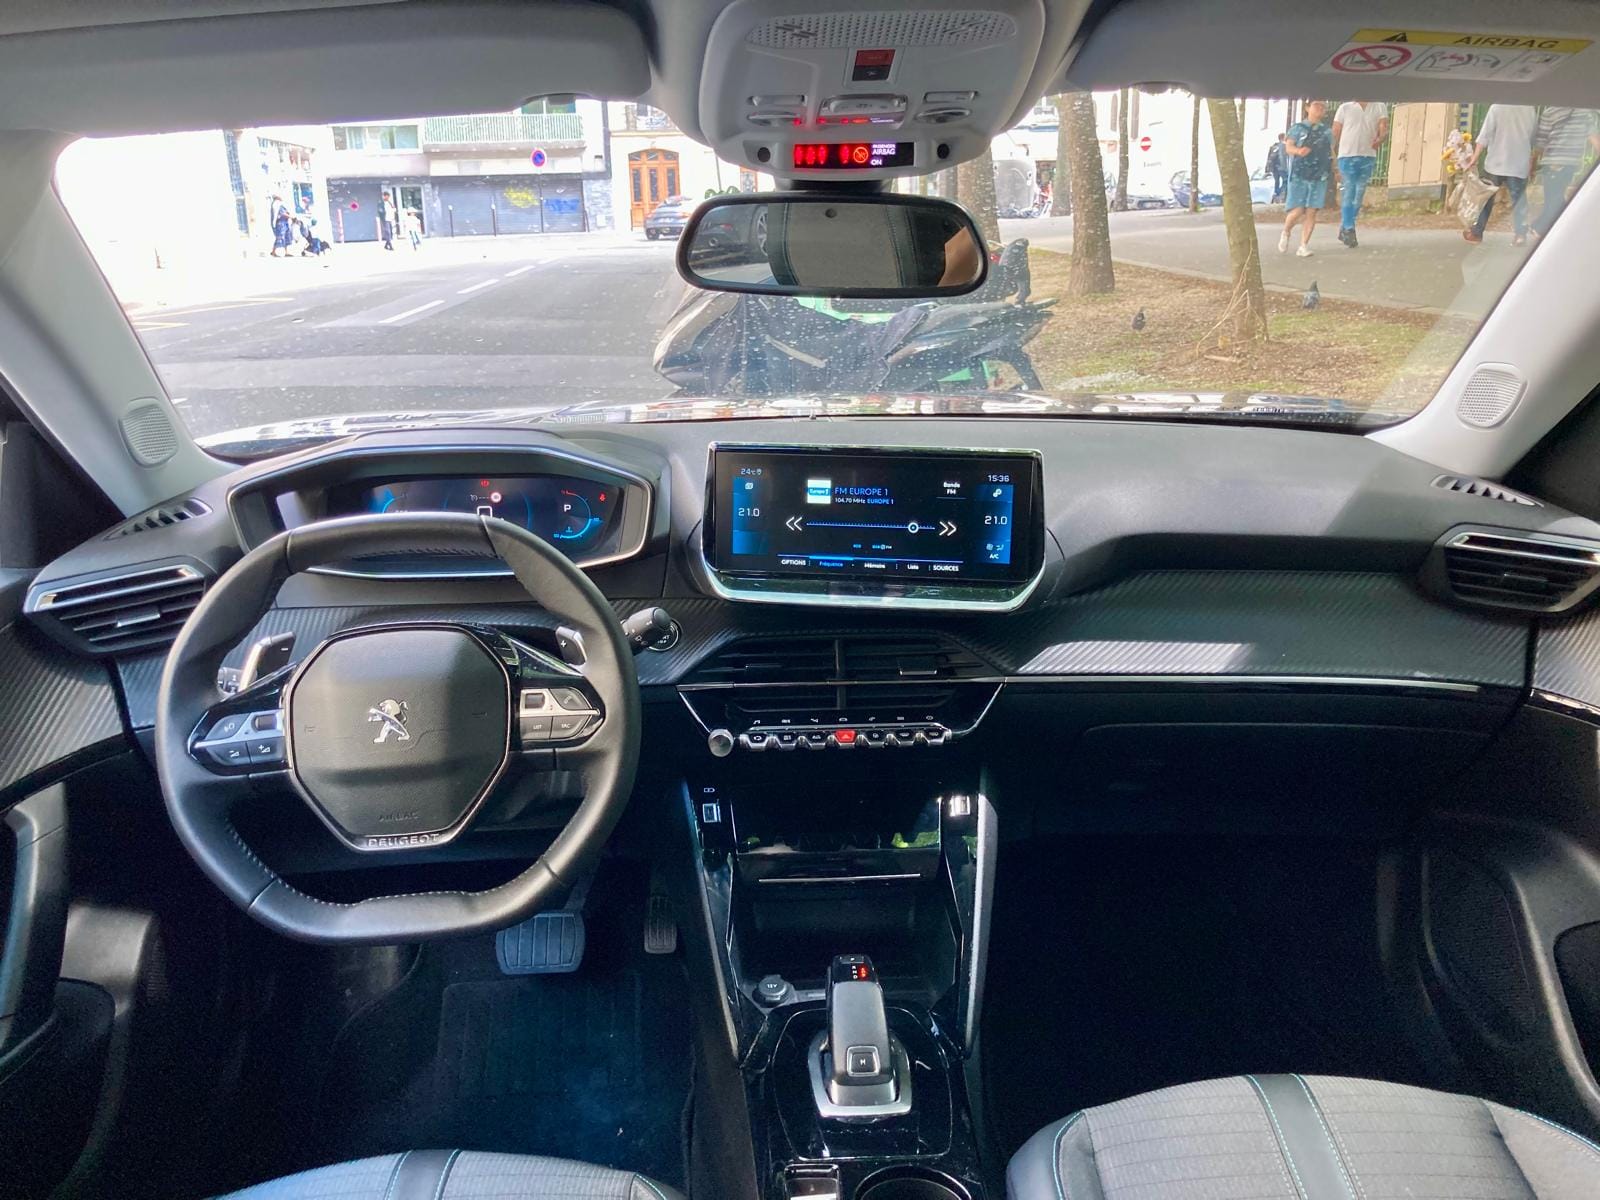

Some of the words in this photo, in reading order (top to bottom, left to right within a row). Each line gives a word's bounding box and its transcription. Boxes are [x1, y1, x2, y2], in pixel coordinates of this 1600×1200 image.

[1454, 36, 1560, 49] AIRBAG
[834, 487, 848, 495] FM
[849, 487, 882, 496] EUROPE
[884, 488, 888, 496] 1
[563, 504, 571, 512] P
[738, 507, 760, 517] 21.0
[984, 515, 1008, 525] 21.0
[367, 833, 440, 848] PEUGEOT
